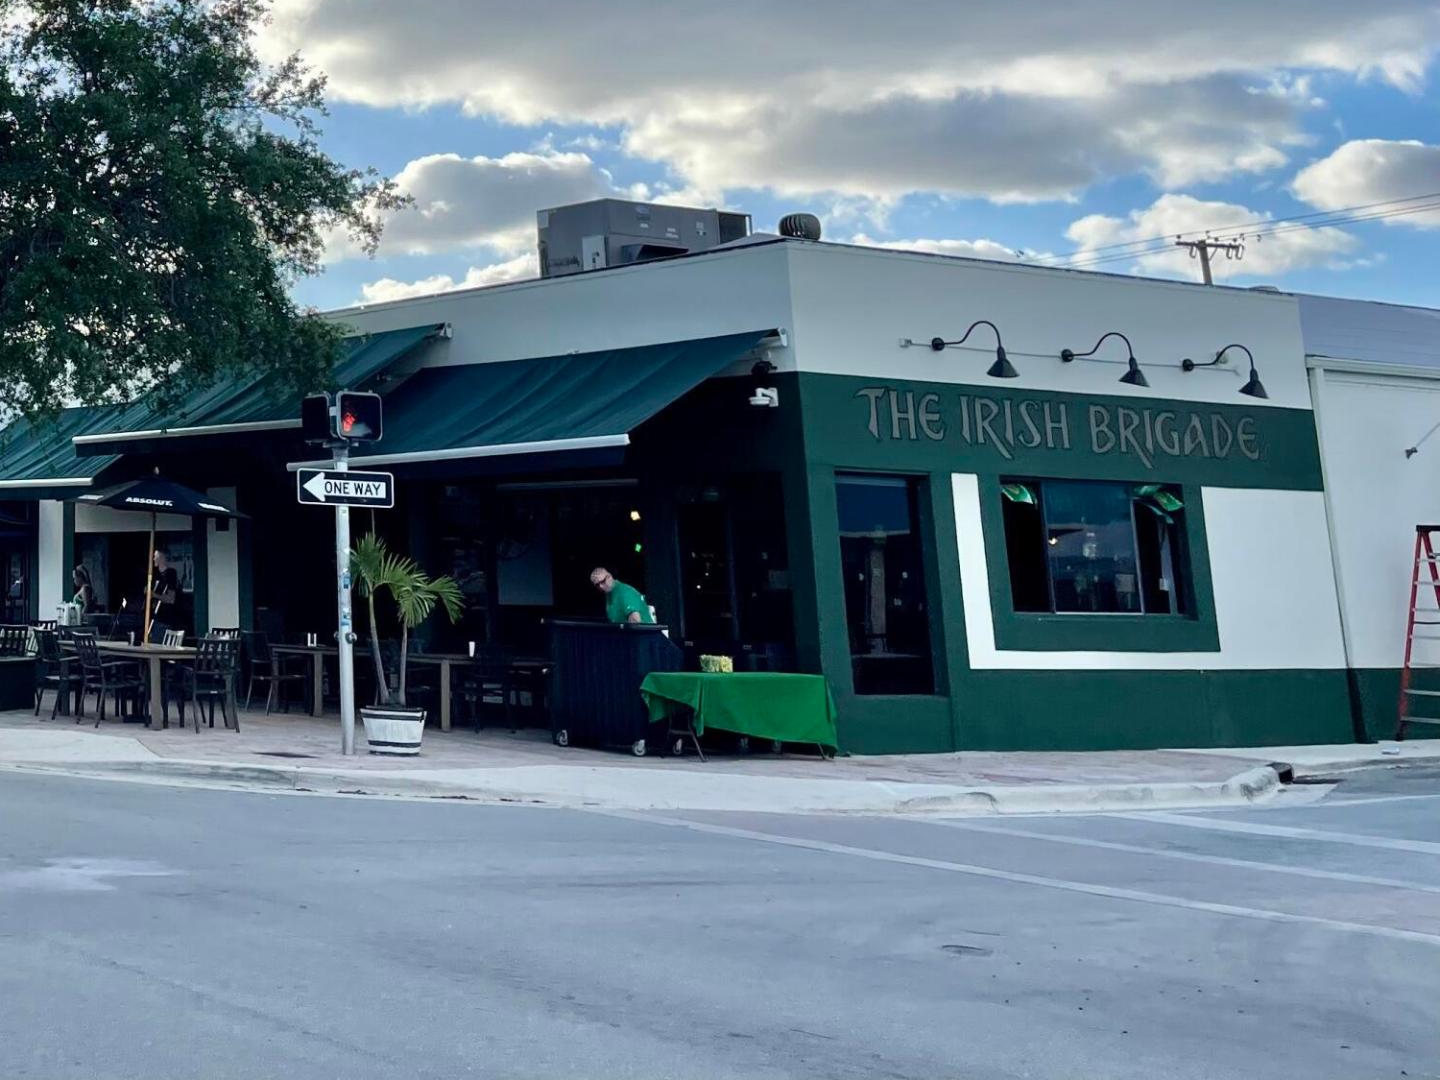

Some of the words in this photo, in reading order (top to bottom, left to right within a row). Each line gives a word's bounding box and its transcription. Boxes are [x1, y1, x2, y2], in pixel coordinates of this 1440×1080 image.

[855, 387, 945, 440] THE
[960, 393, 1071, 460] IRISH
[1088, 404, 1261, 469] BRIGADE
[324, 481, 350, 495] ONE
[354, 482, 381, 496] WAY
